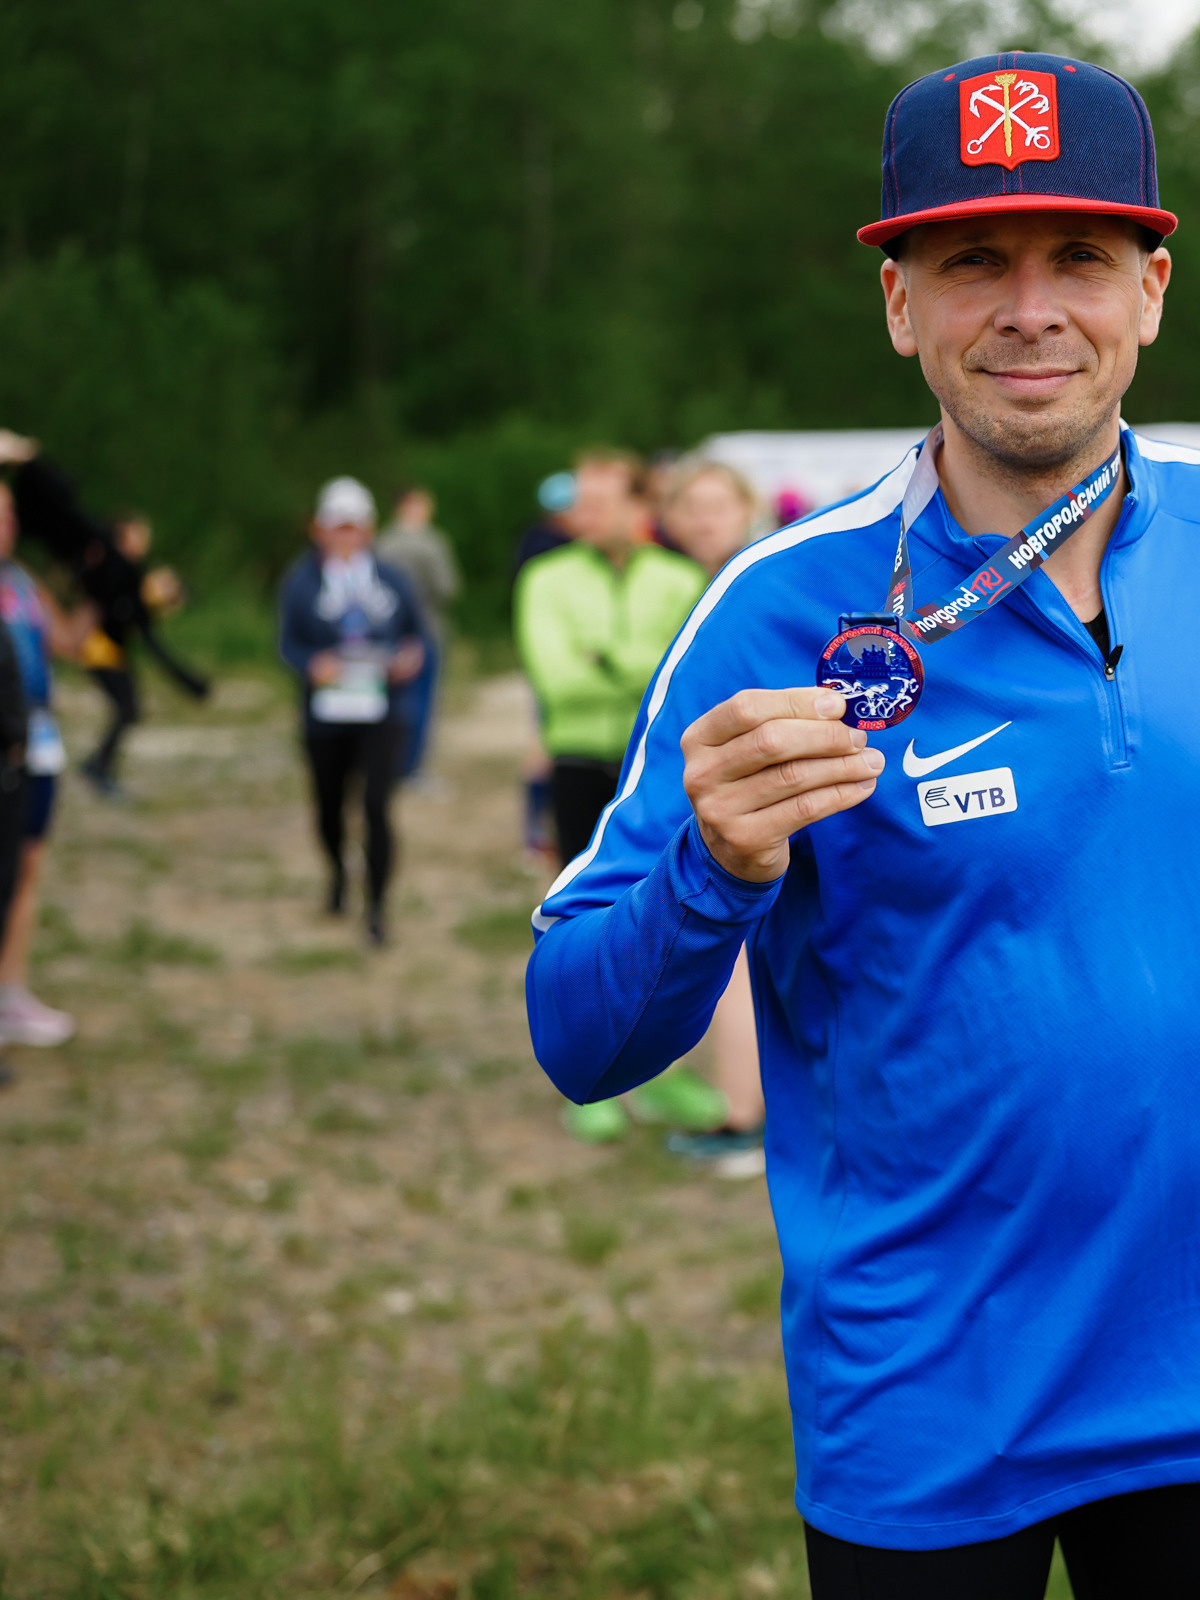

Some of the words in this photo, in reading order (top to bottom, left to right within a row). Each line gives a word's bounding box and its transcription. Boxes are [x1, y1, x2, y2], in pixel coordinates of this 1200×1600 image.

[1008, 465, 1110, 570] НОВГОРОДСКИЙ
[822, 625, 882, 660] НОВГОРОДСКИЙ
[882, 628, 917, 660] ТРИАТЛОН
[857, 720, 886, 730] 2023
[954, 787, 1006, 813] VTB
